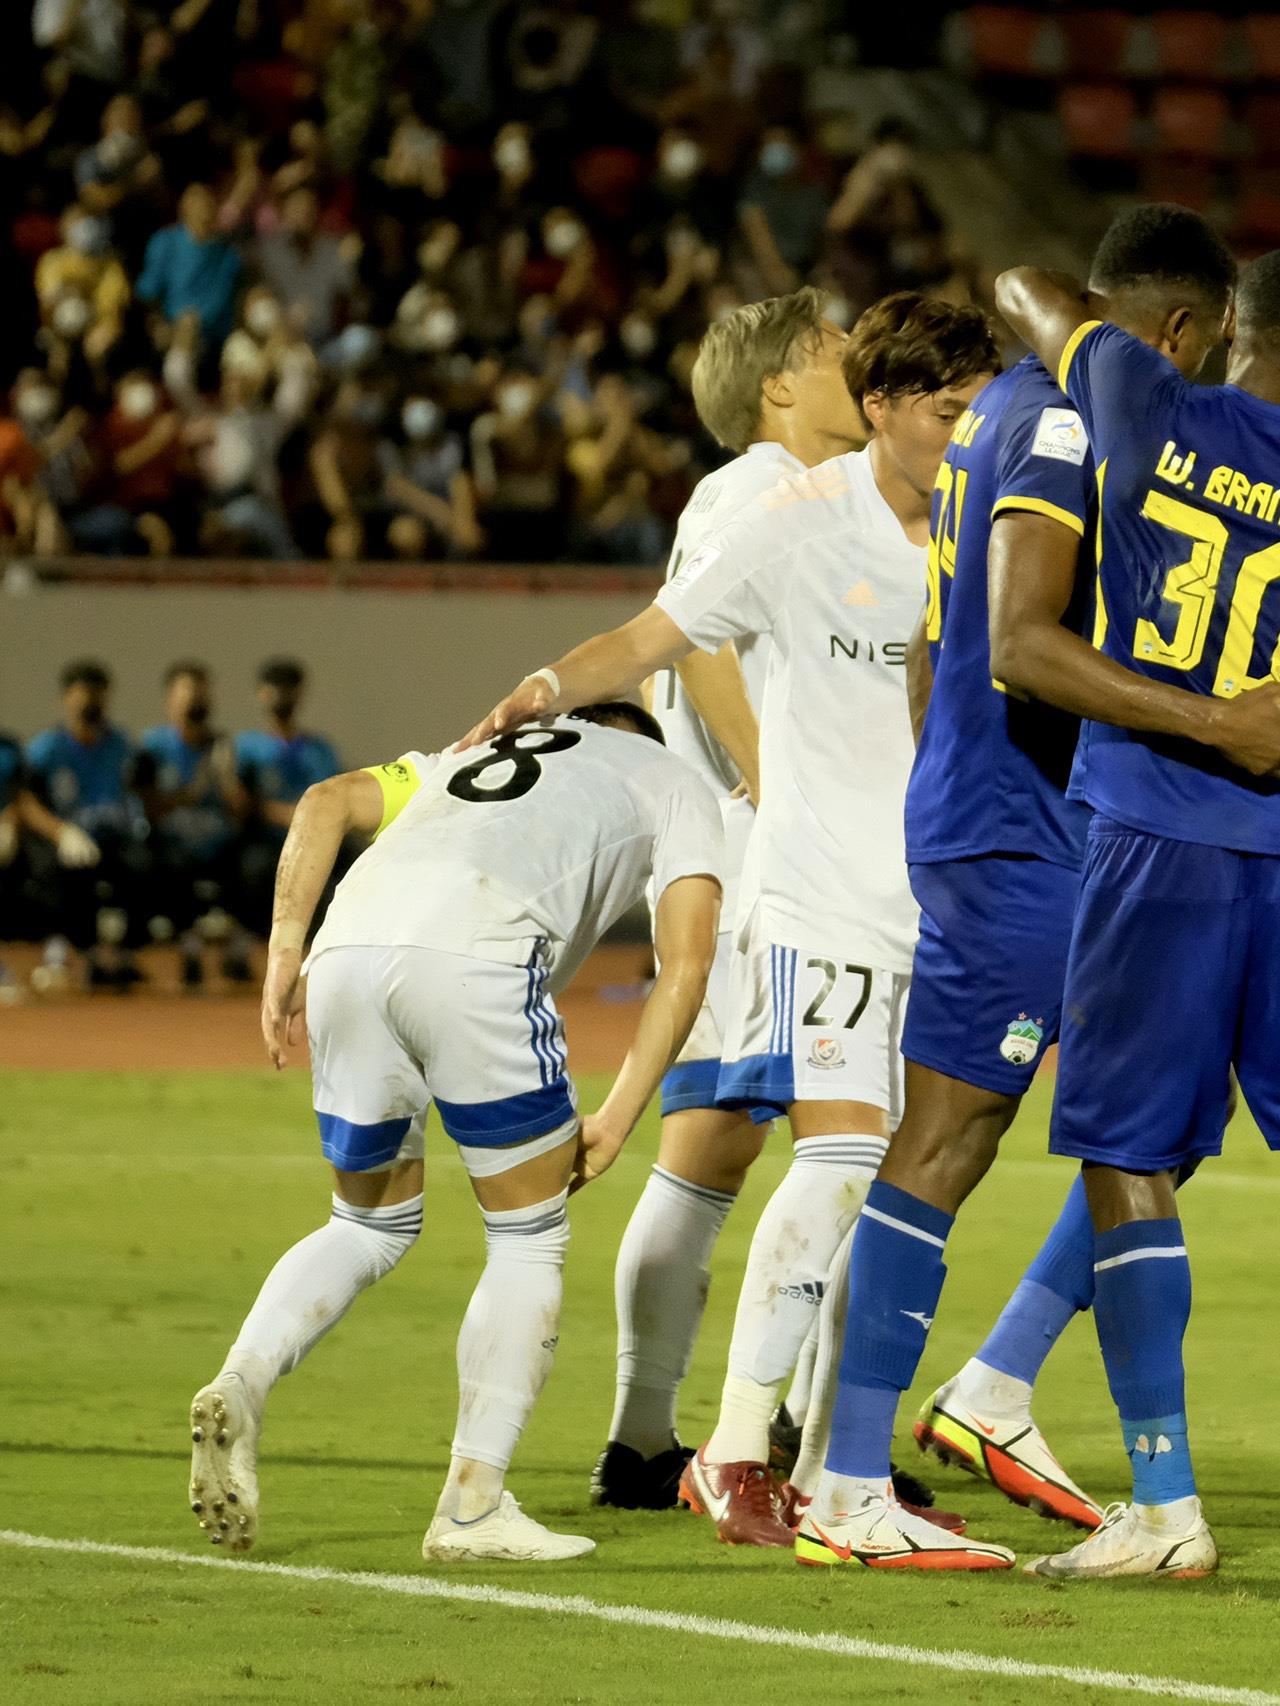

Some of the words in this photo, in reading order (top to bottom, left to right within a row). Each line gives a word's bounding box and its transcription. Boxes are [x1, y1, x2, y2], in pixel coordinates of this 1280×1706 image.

[1154, 440, 1197, 490] W.
[446, 727, 583, 803] 8
[802, 958, 873, 1030] 27
